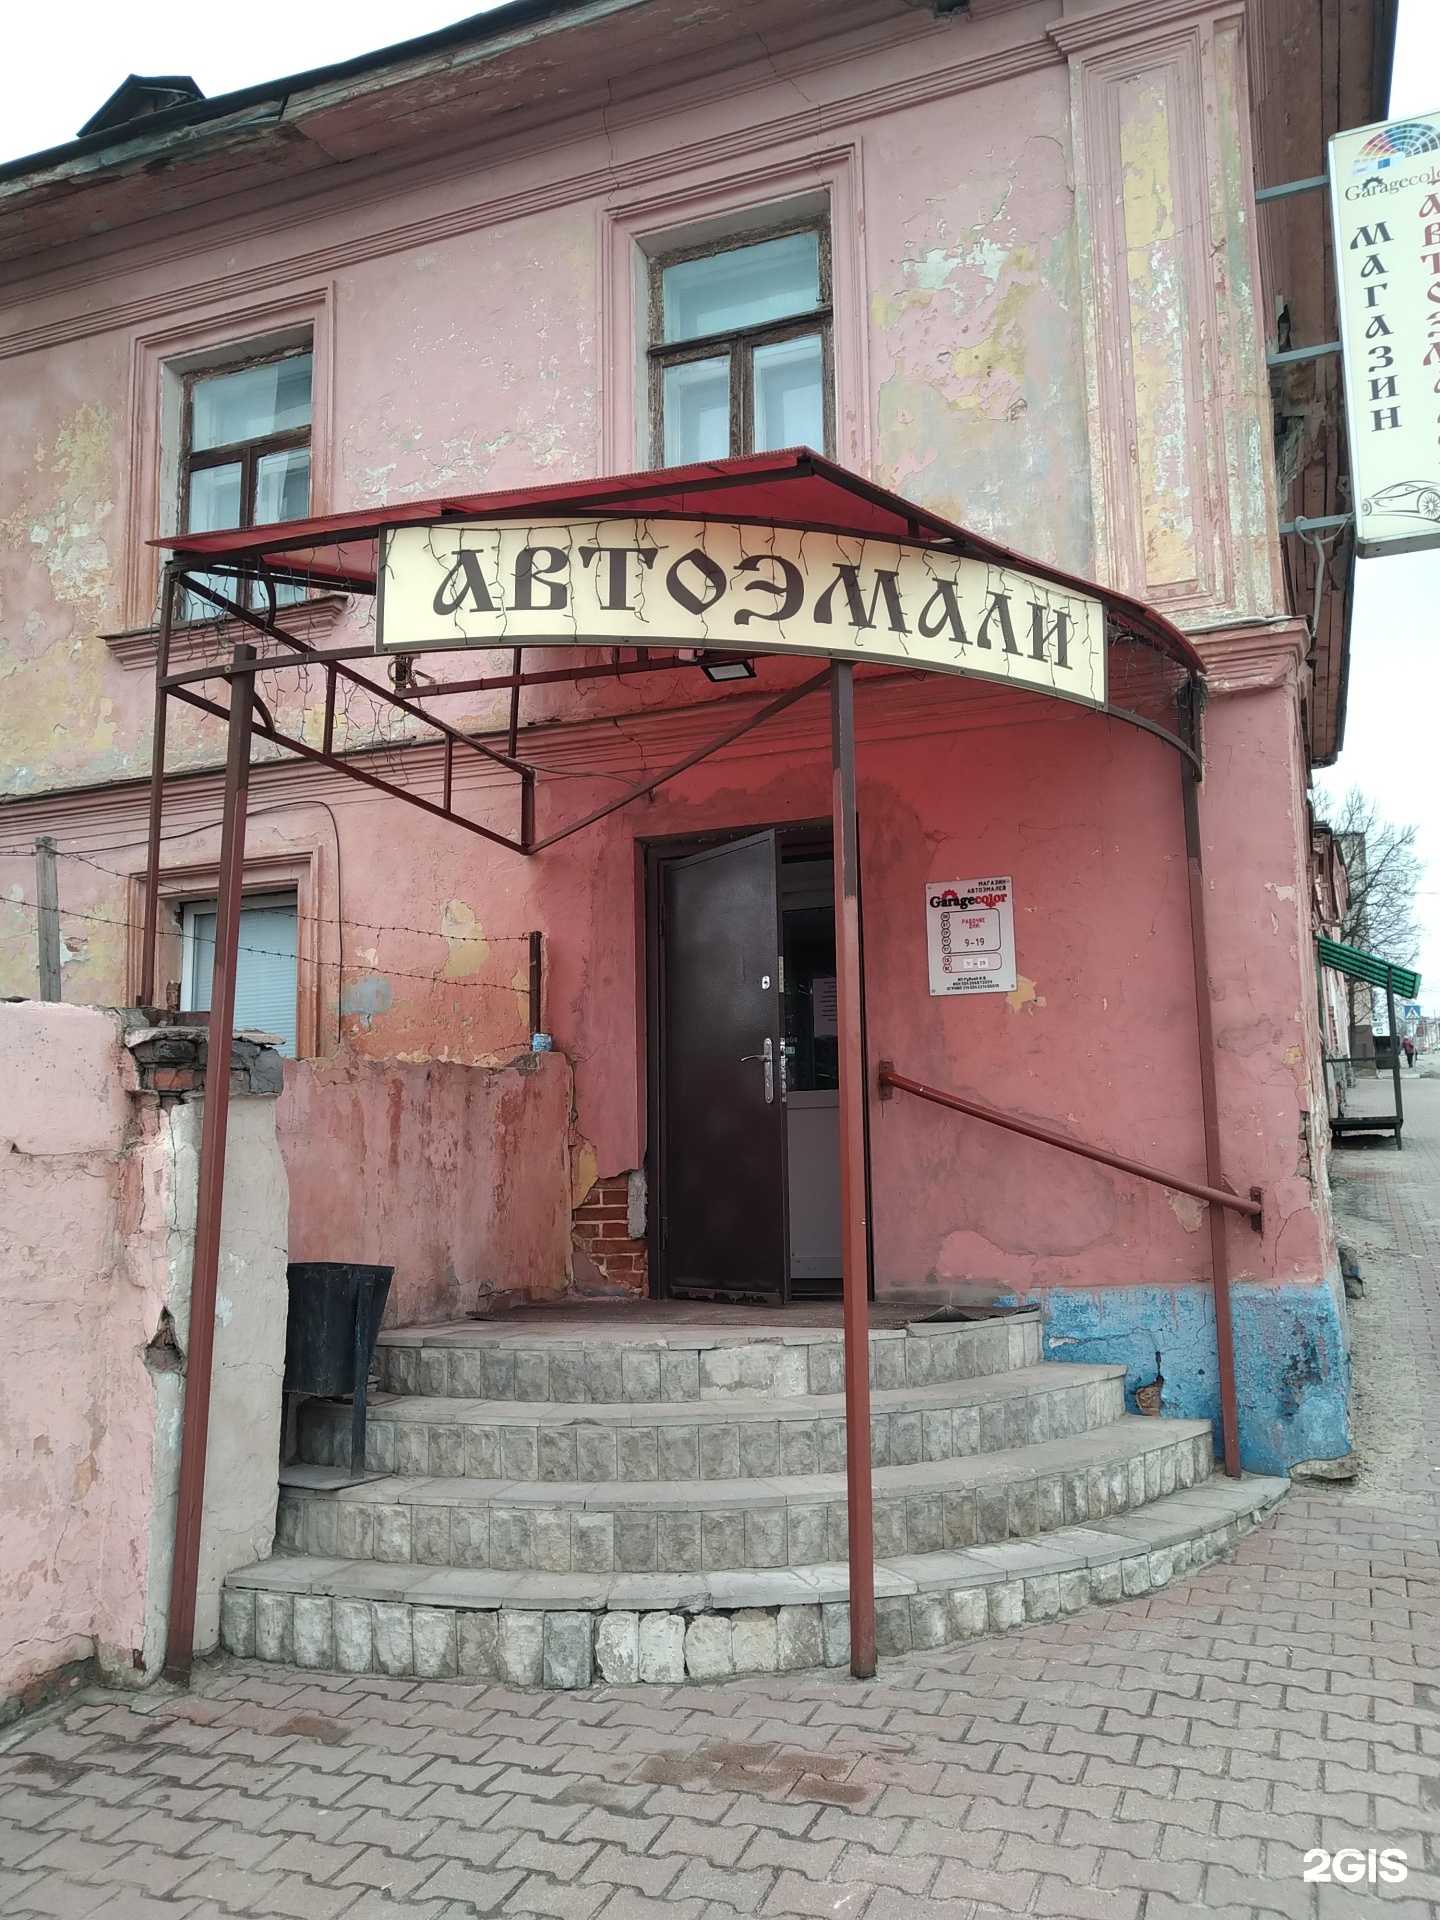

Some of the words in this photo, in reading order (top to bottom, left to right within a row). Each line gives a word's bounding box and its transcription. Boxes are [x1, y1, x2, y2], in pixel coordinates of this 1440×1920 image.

[1345, 166, 1440, 200] Garagecol
[1350, 220, 1402, 432] МАГАЗИН
[432, 546, 1074, 670] АВТОЭМАЛИ
[930, 893, 1007, 909] Garagecolor
